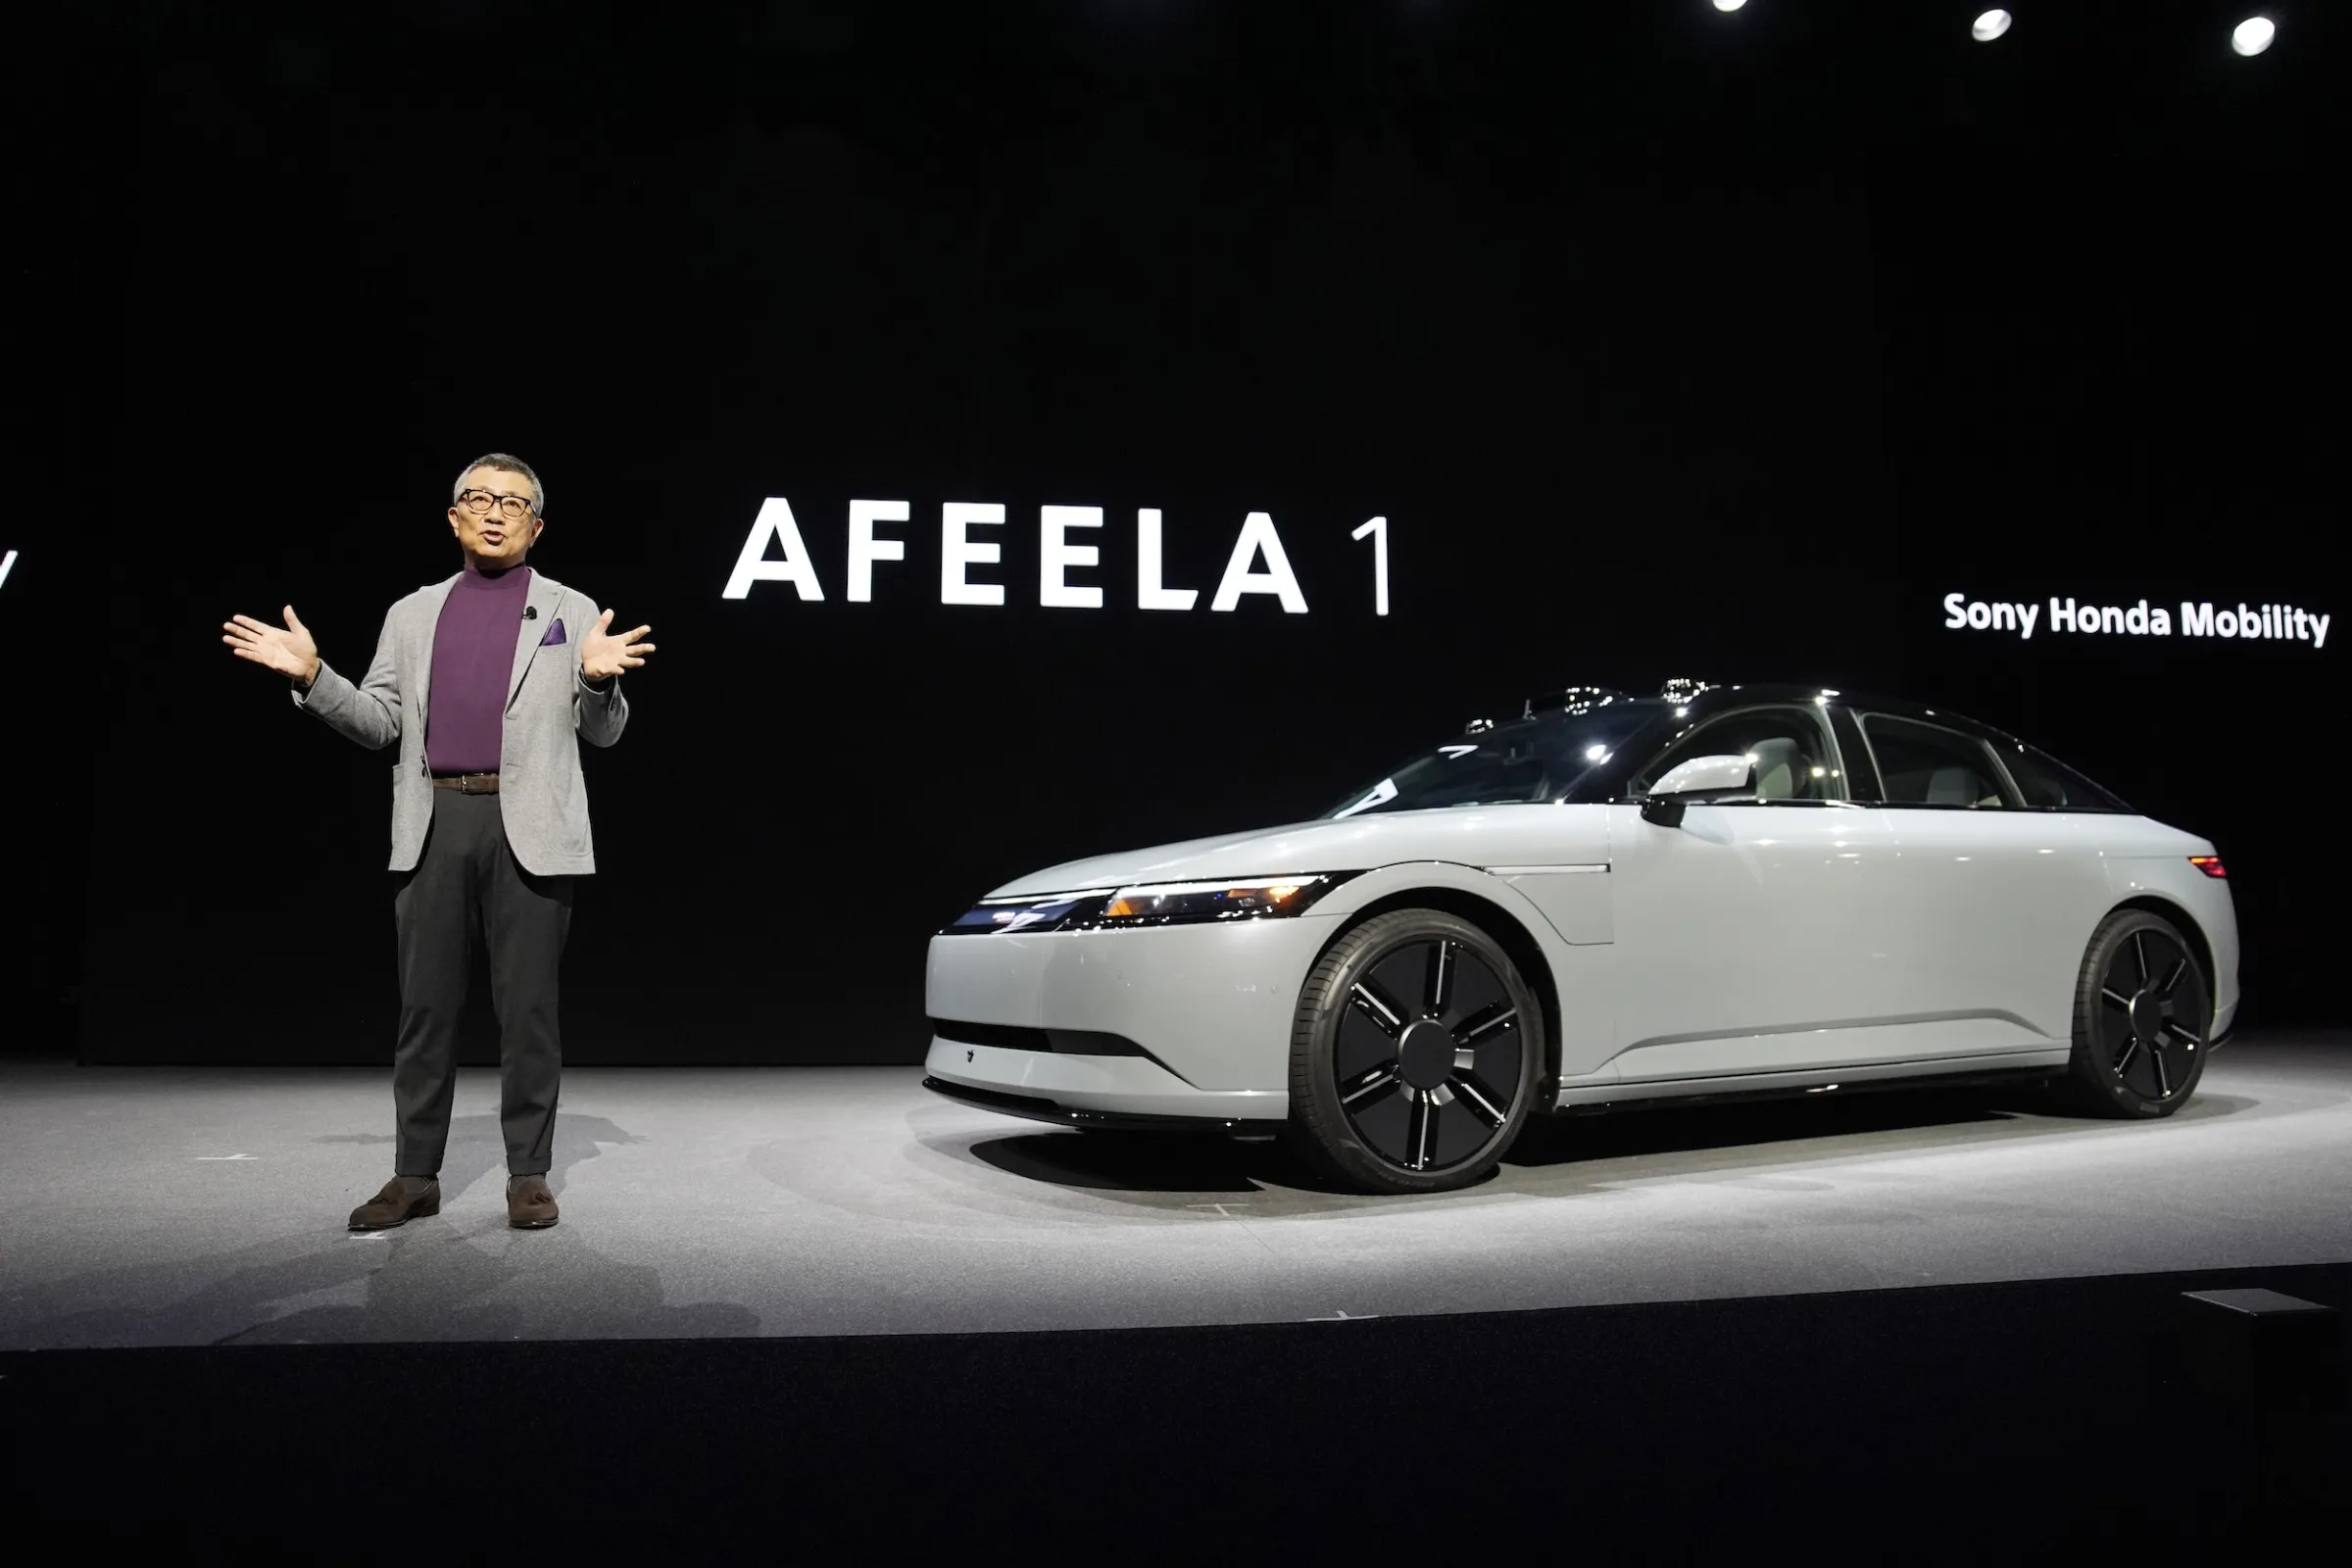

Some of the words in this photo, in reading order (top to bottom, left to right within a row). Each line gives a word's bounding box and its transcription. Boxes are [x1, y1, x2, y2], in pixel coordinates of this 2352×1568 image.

[721, 497, 1309, 615] AFEELA
[1350, 515, 1391, 616] 1
[1943, 592, 2039, 640] Sony
[2049, 597, 2173, 636] Honda
[2180, 601, 2331, 649] Mobility
